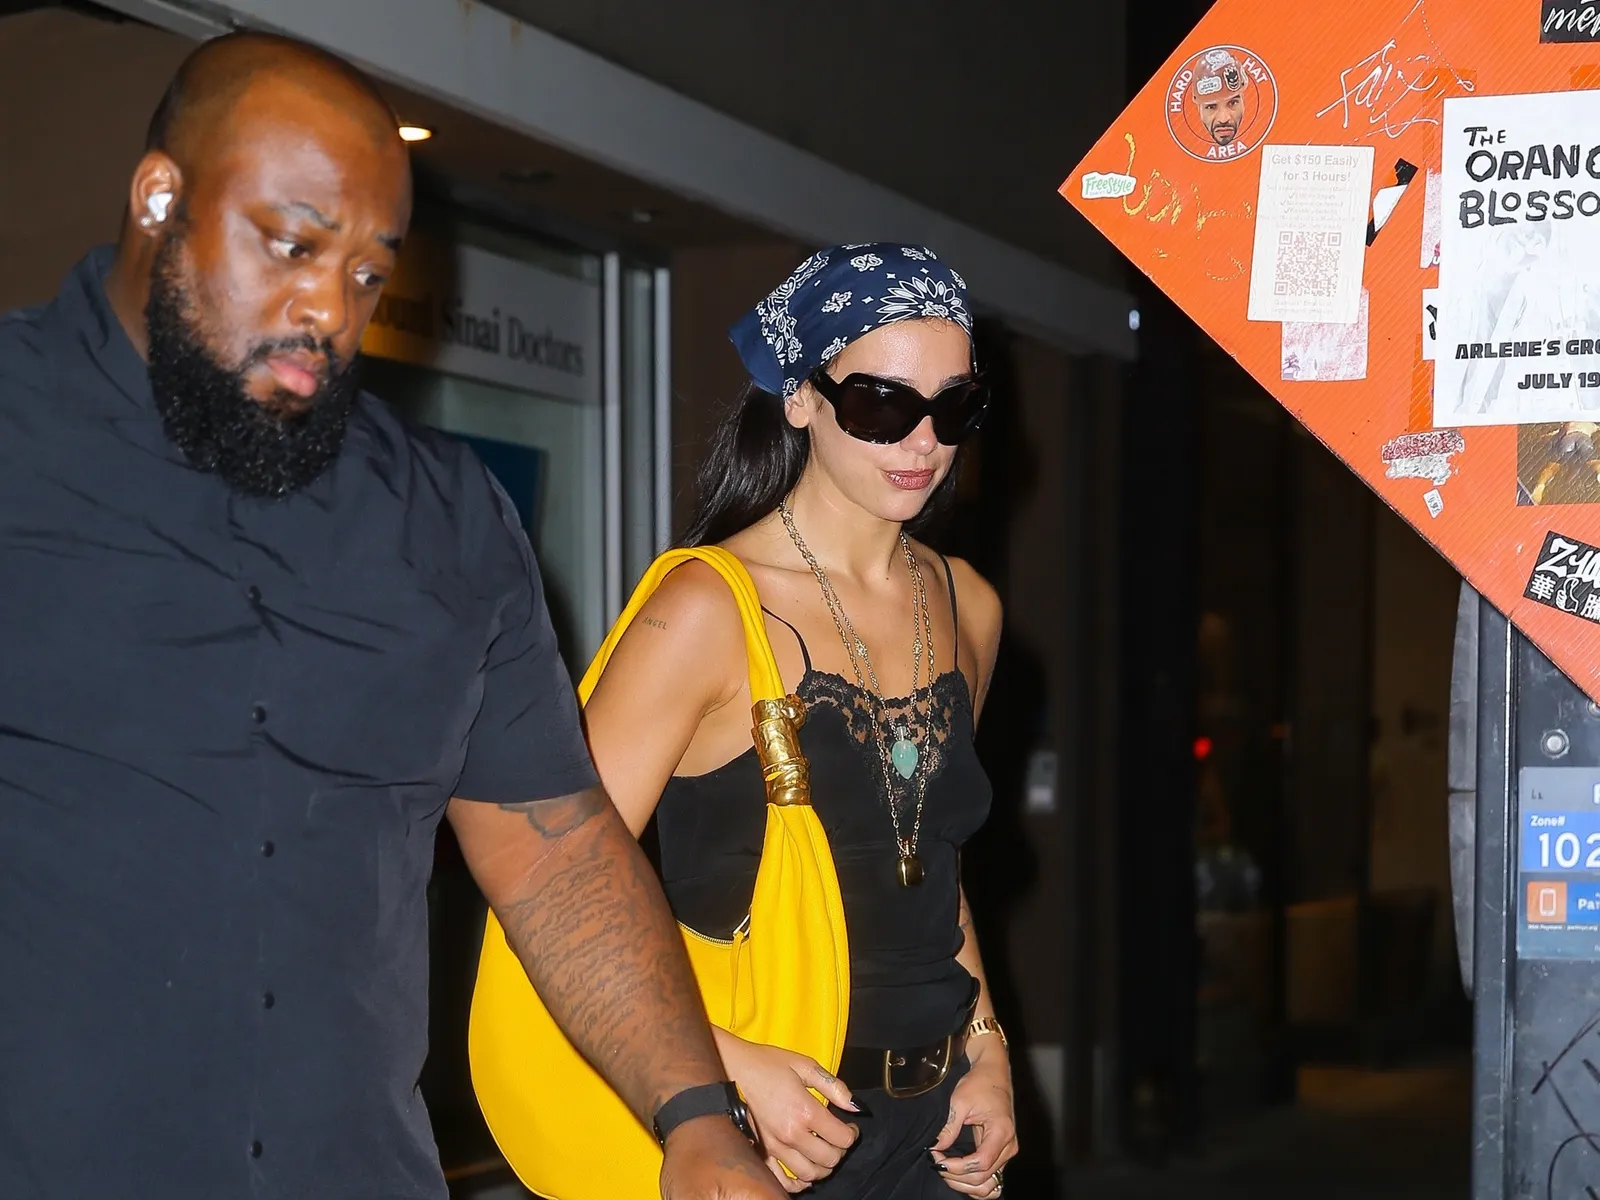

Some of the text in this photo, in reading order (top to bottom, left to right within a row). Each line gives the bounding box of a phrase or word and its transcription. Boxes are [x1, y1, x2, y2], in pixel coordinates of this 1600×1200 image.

[1170, 69, 1193, 113] HARD
[1242, 57, 1268, 84] HAT
[1463, 126, 1507, 147] THE
[1205, 140, 1248, 159] AREA
[1271, 153, 1359, 168] Get $150 Easily
[1283, 170, 1351, 182] for 3 Hours!
[1459, 188, 1600, 228] BLOSSO
[507, 315, 585, 378] Doctors
[1455, 338, 1561, 360] ARLENE'S
[1517, 372, 1600, 390] JULY 19
[642, 616, 667, 631] ANGEL
[1530, 815, 1566, 827] Zone#
